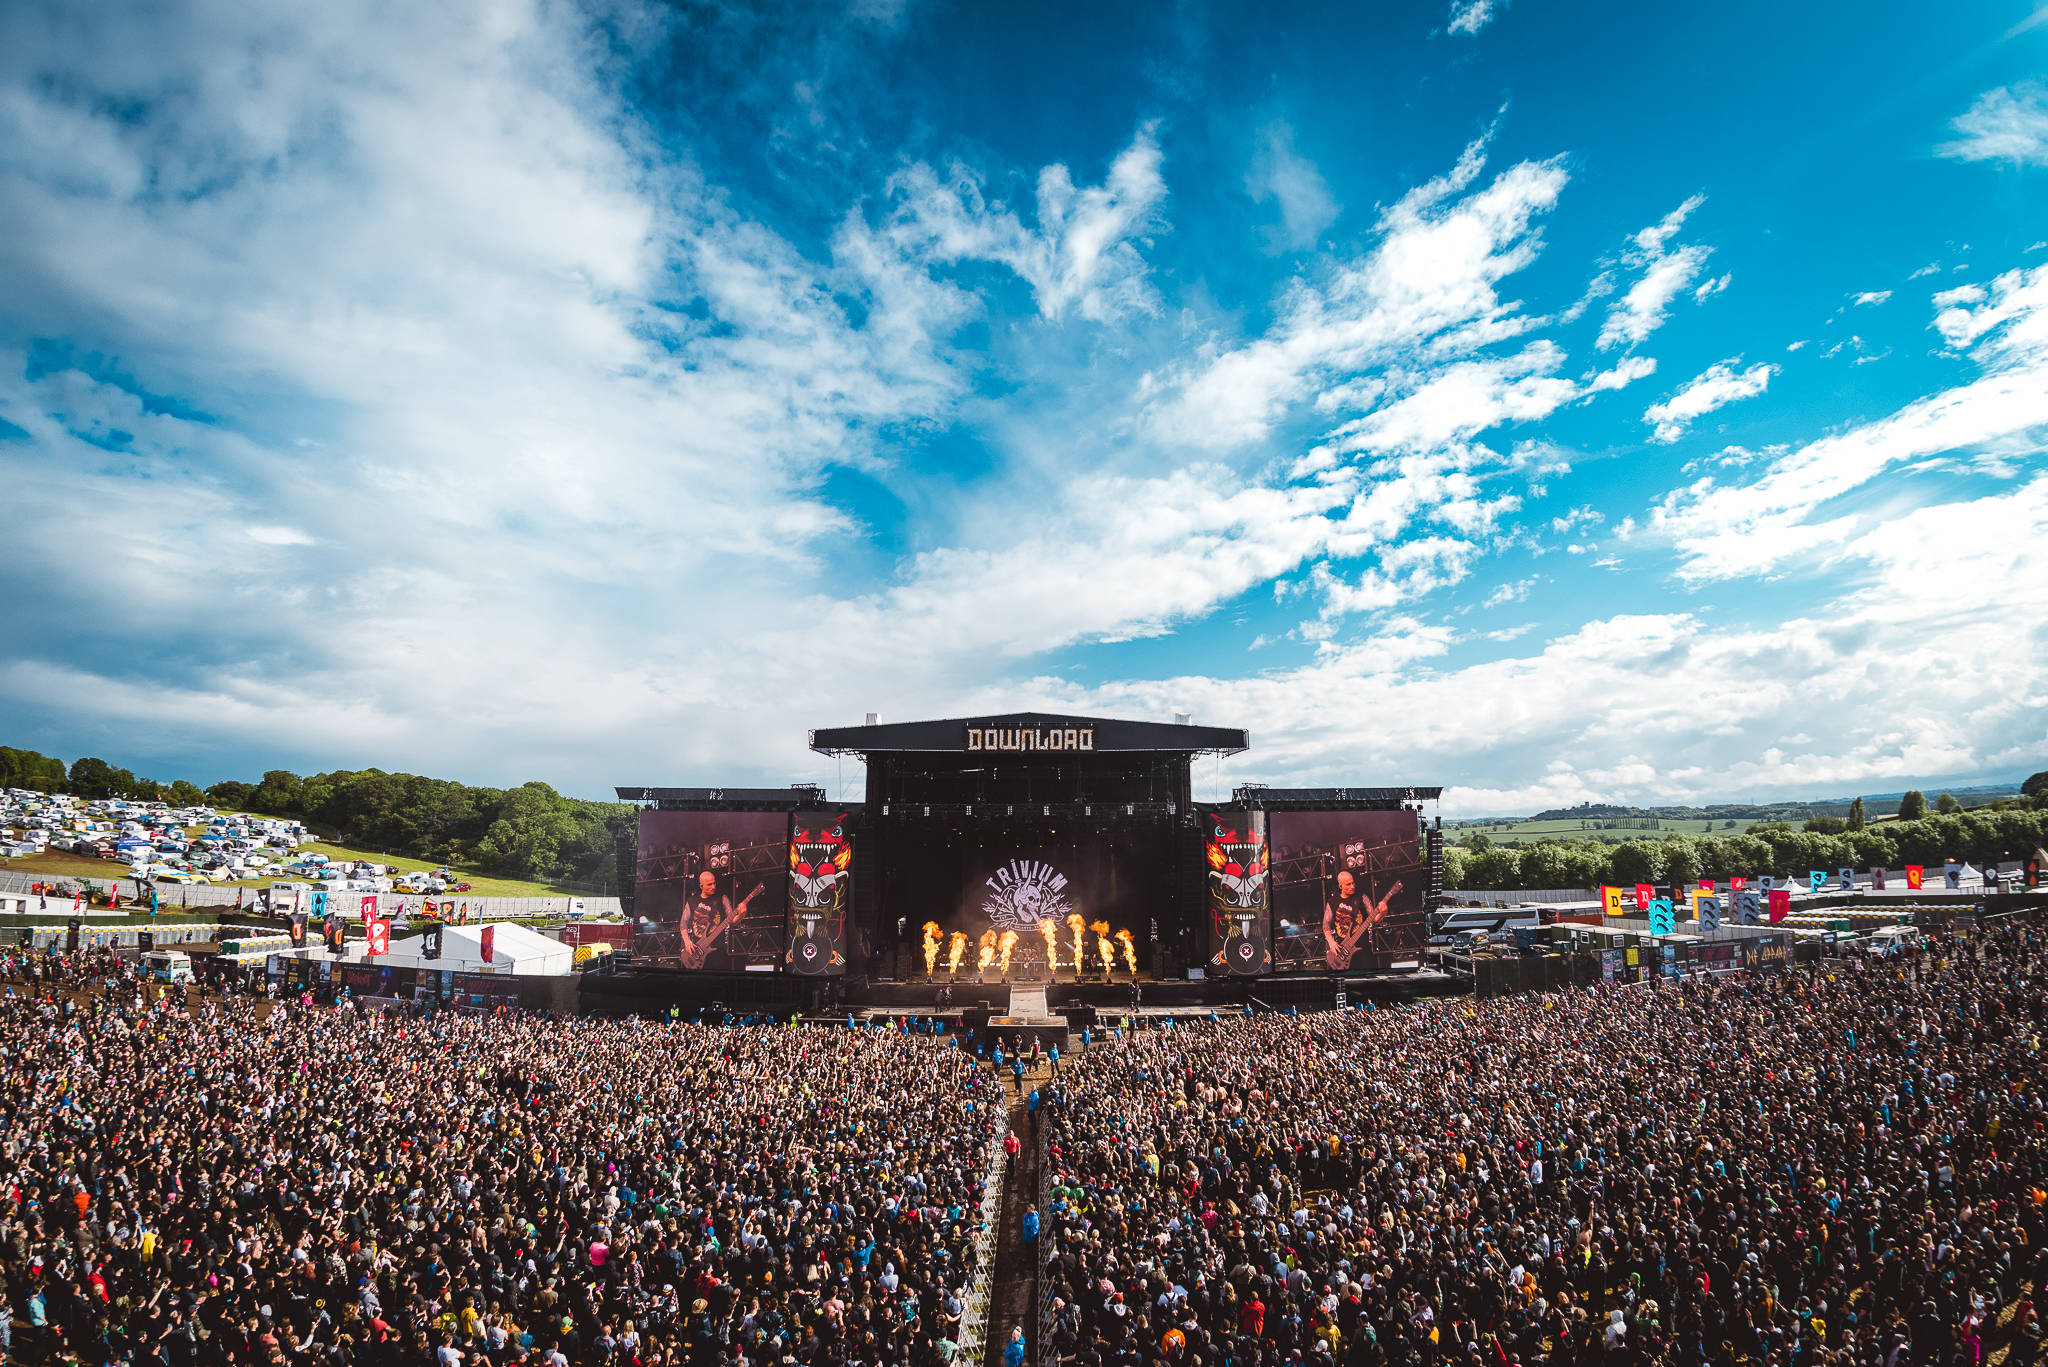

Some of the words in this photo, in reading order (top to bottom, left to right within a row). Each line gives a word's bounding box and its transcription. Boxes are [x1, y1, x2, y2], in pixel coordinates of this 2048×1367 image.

[968, 729, 1093, 750] DOWNLOAD
[985, 858, 1068, 893] TRIVIUM
[1611, 896, 1619, 907] D
[1641, 891, 1649, 902] D
